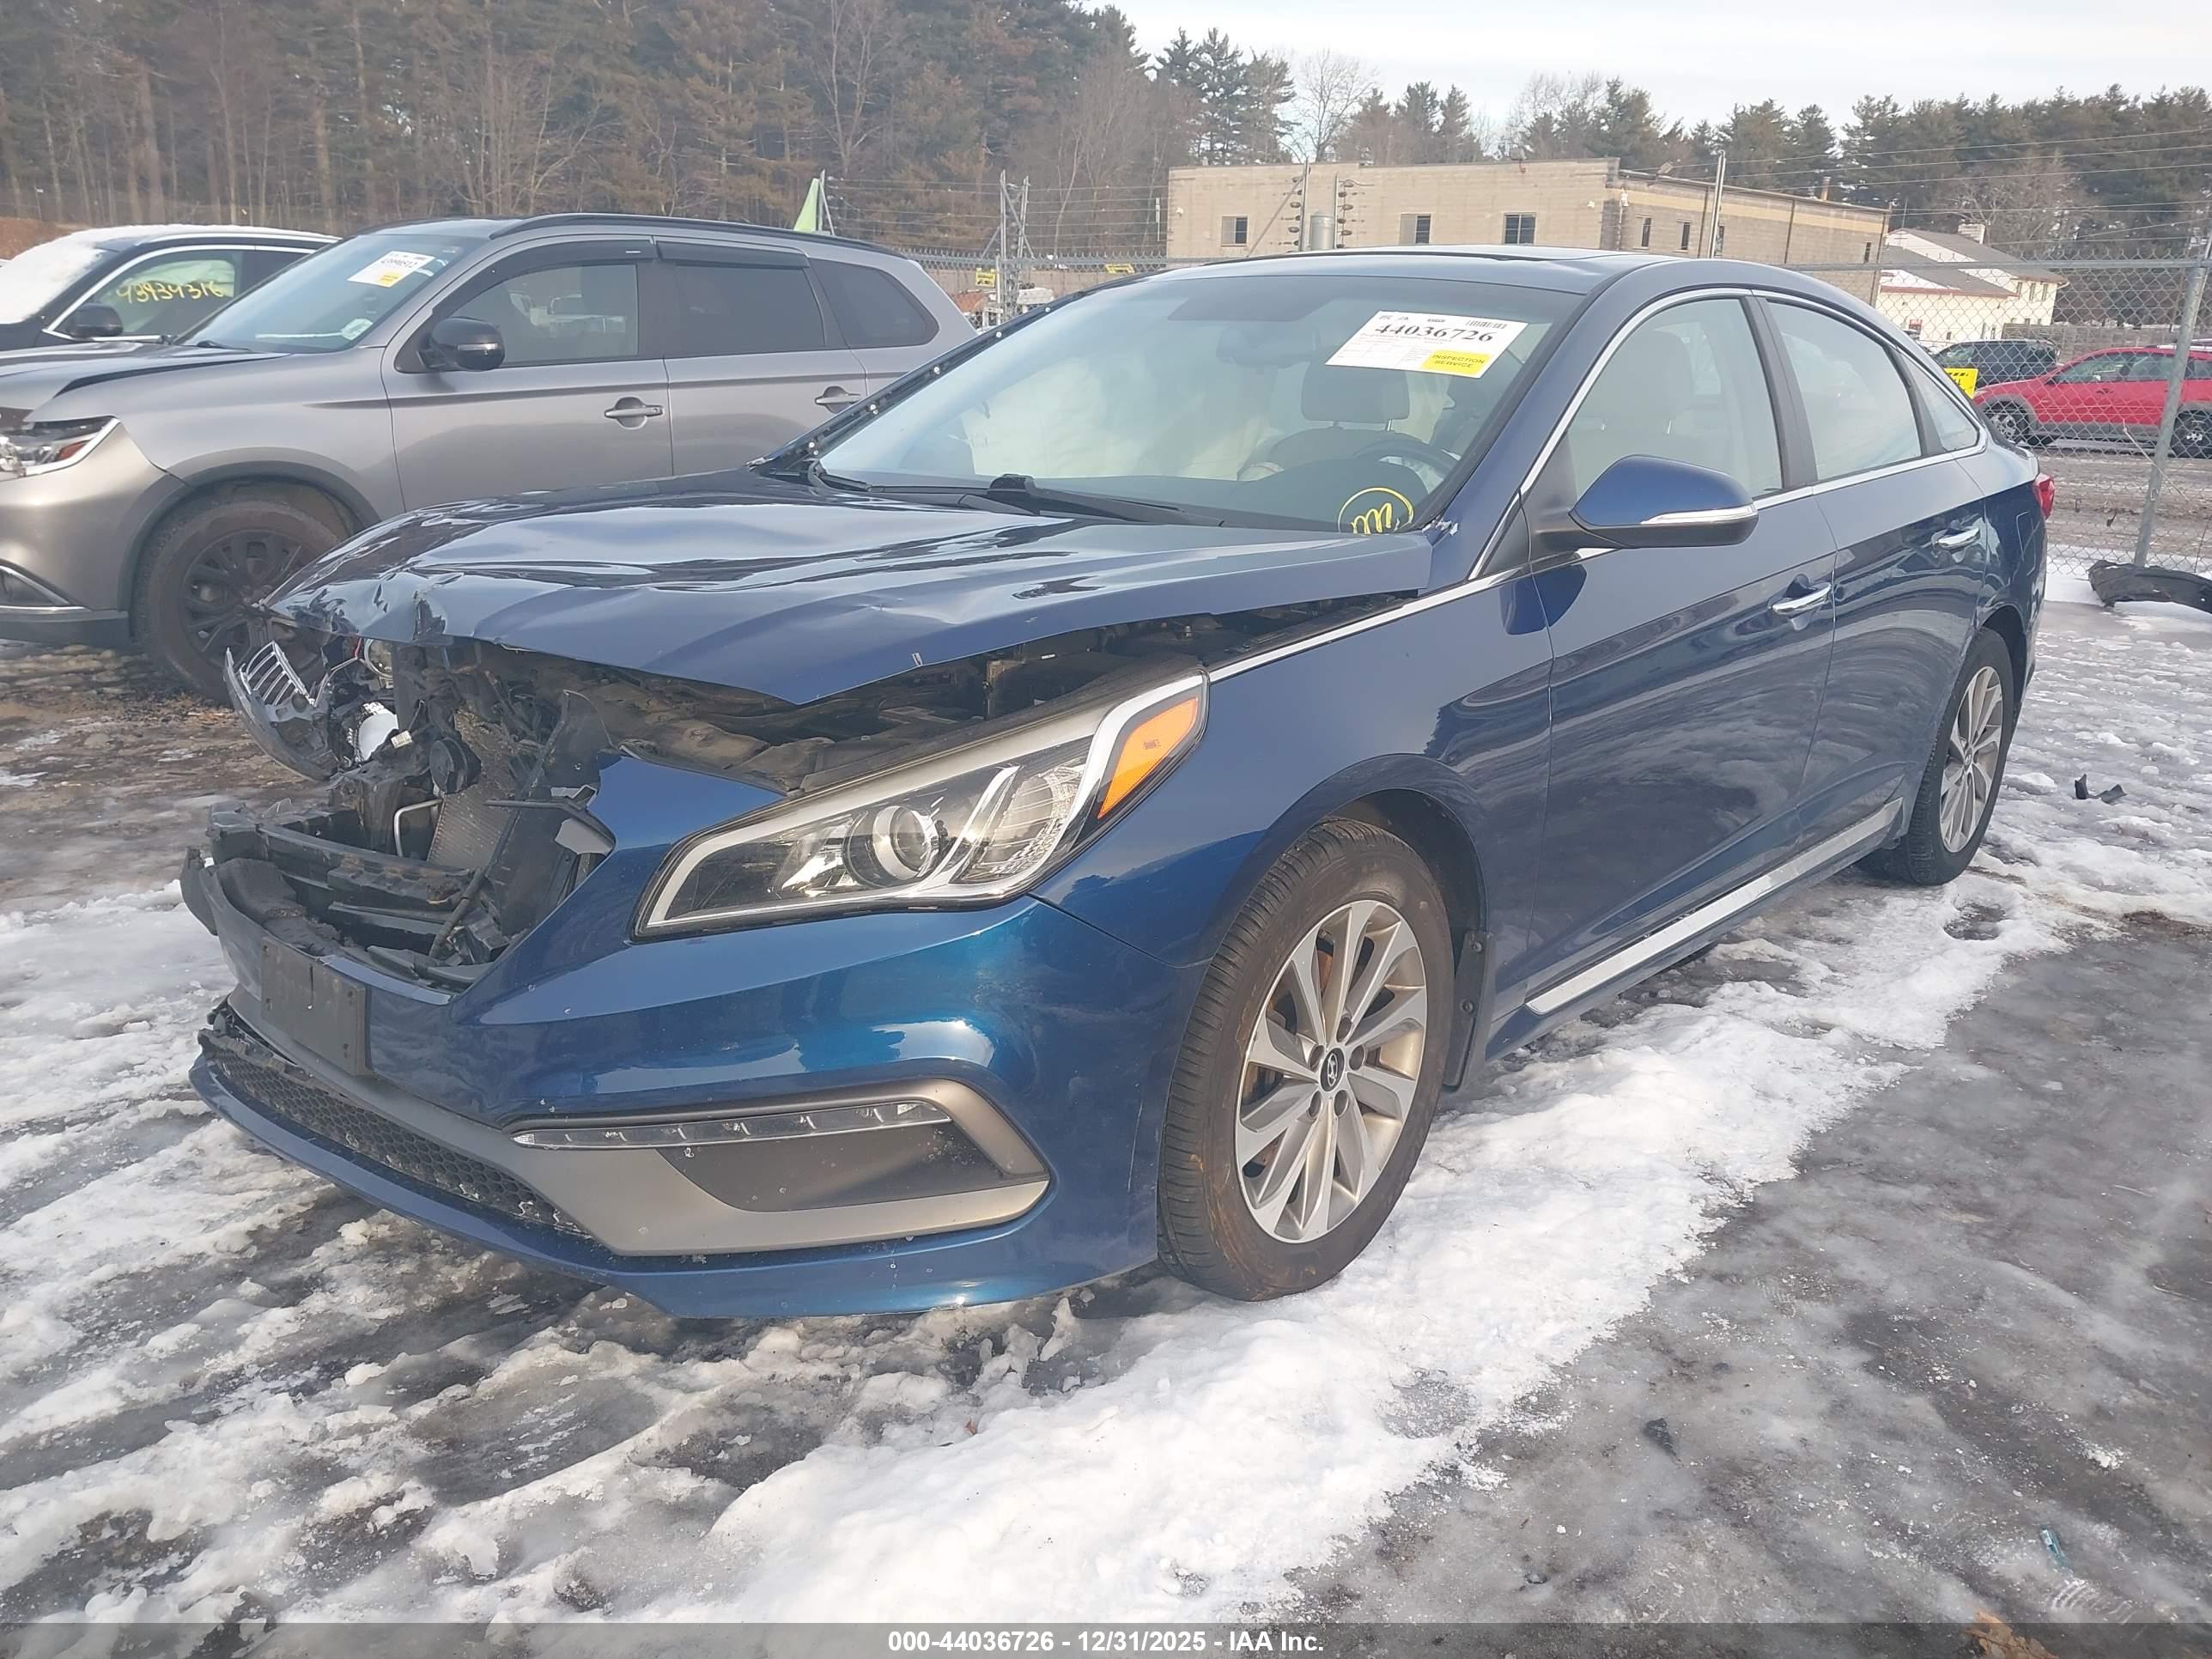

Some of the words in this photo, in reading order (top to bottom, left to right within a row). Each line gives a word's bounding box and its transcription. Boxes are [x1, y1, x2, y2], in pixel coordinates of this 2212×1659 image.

[1375, 323, 1498, 343] 44036726
[1431, 354, 1486, 364] INSPECTION
[1434, 360, 1474, 368] SERVICE
